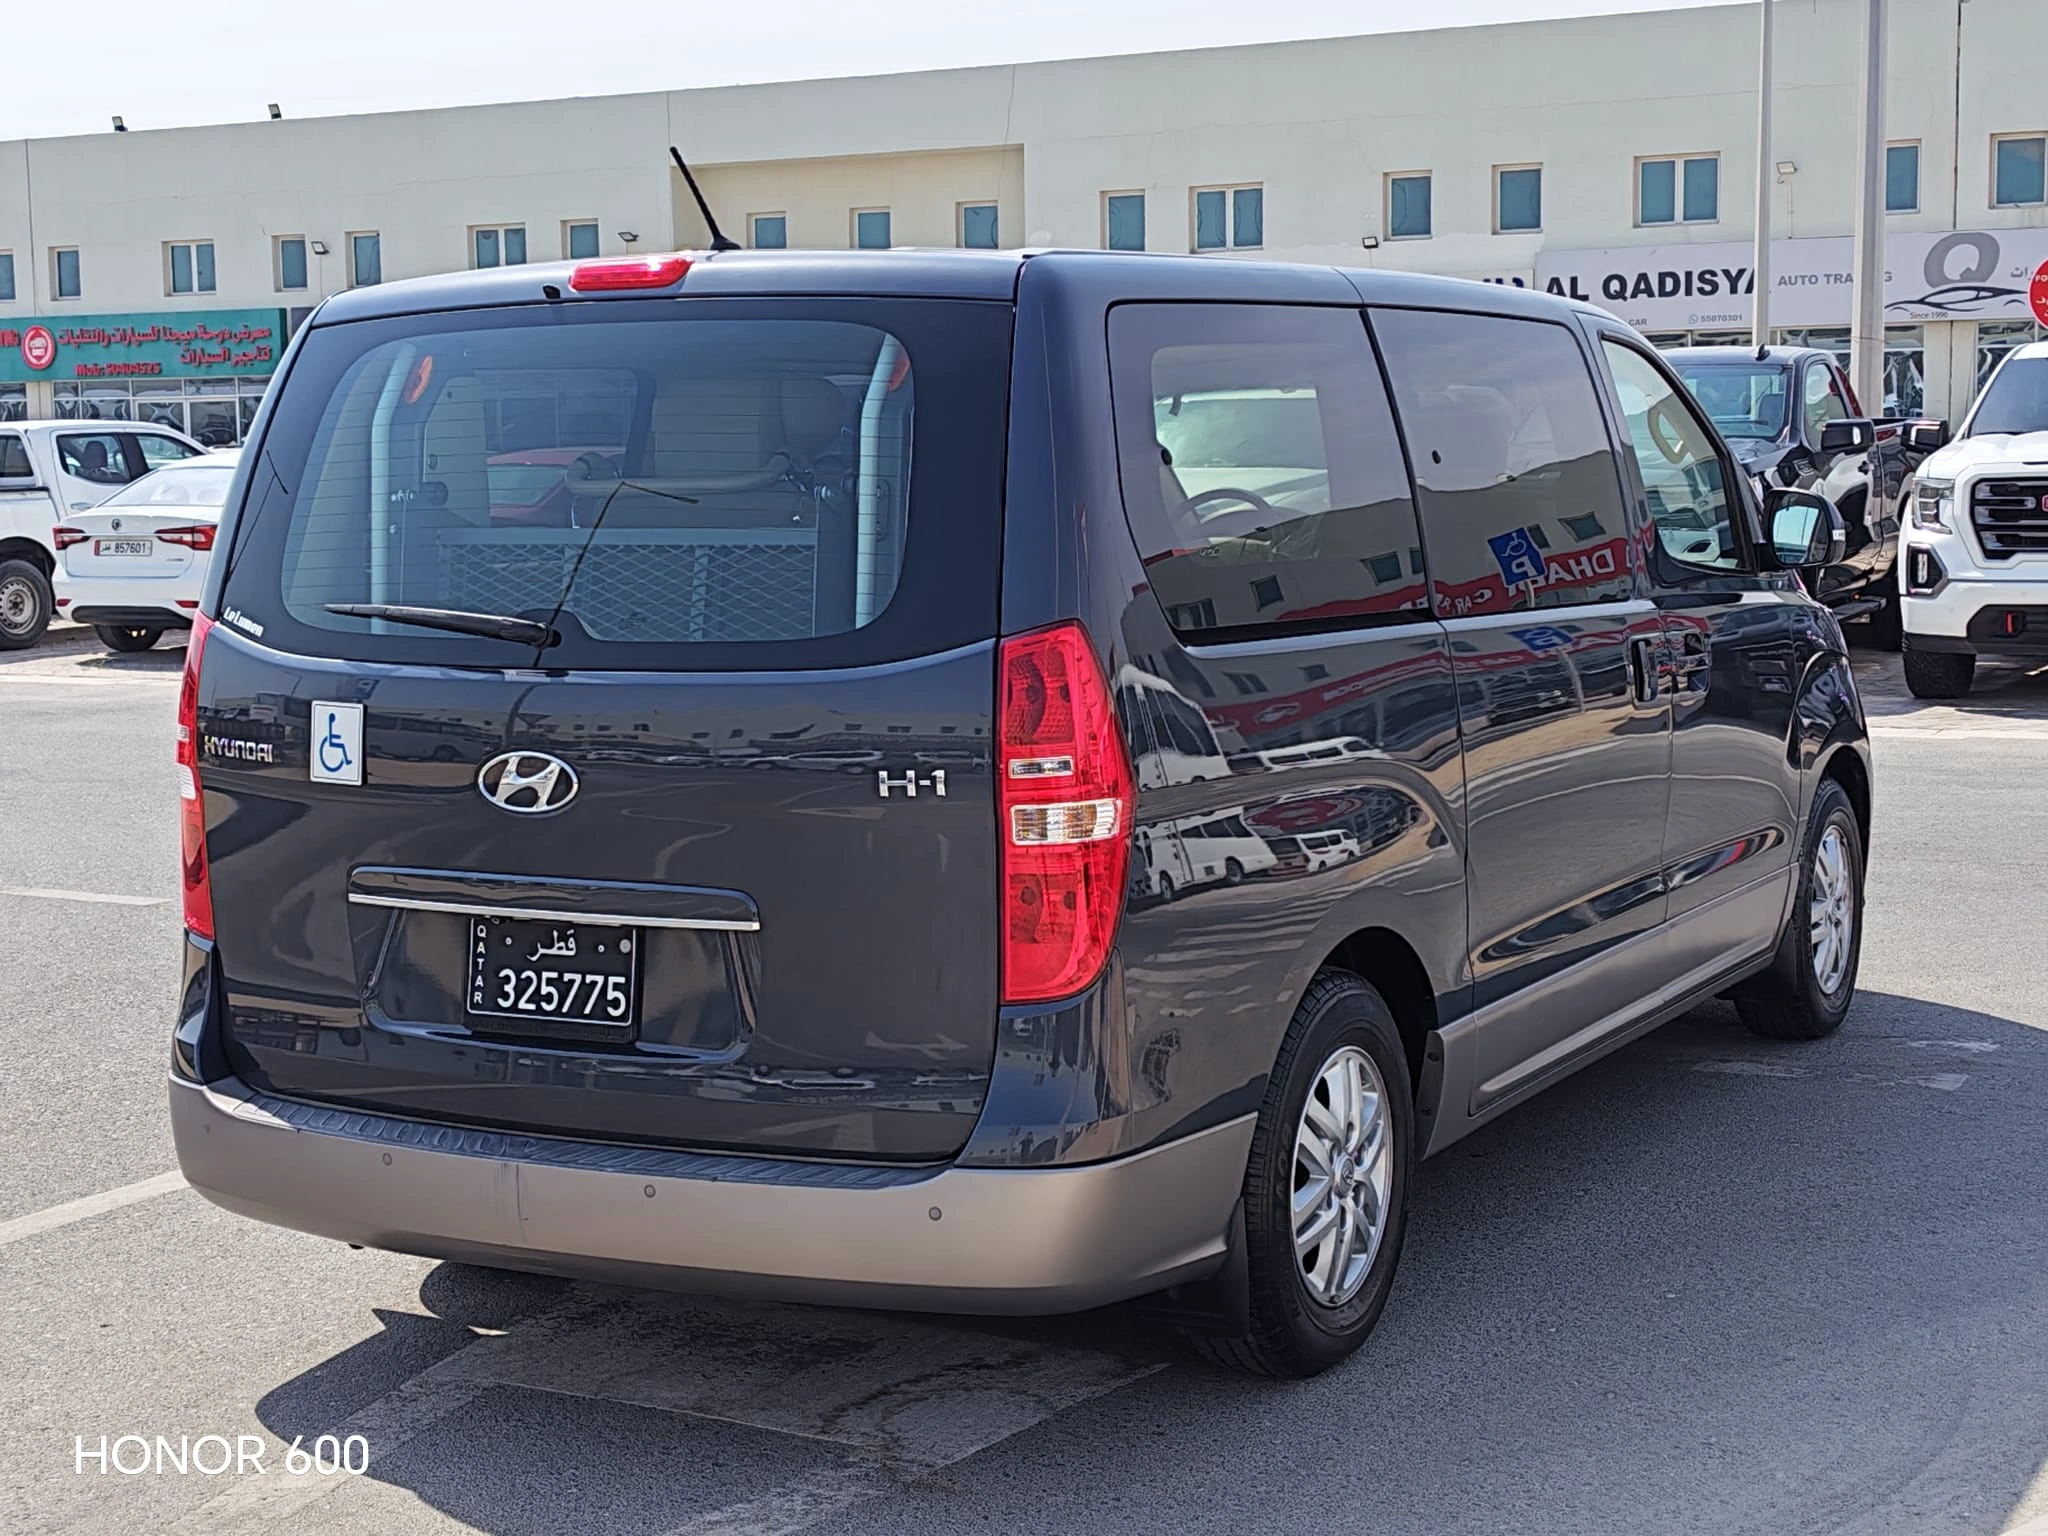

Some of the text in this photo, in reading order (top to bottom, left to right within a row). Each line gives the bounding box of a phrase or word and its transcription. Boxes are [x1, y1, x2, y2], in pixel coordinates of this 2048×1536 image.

[1546, 276, 1589, 302] AL
[1778, 271, 1893, 287] AUTO TRAG
[1628, 318, 1648, 327] CAR
[204, 735, 273, 763] HYUNDAI
[878, 769, 946, 797] H-1
[526, 928, 577, 962] قطر
[473, 924, 487, 1005] QATAR
[496, 968, 627, 1017] 325775
